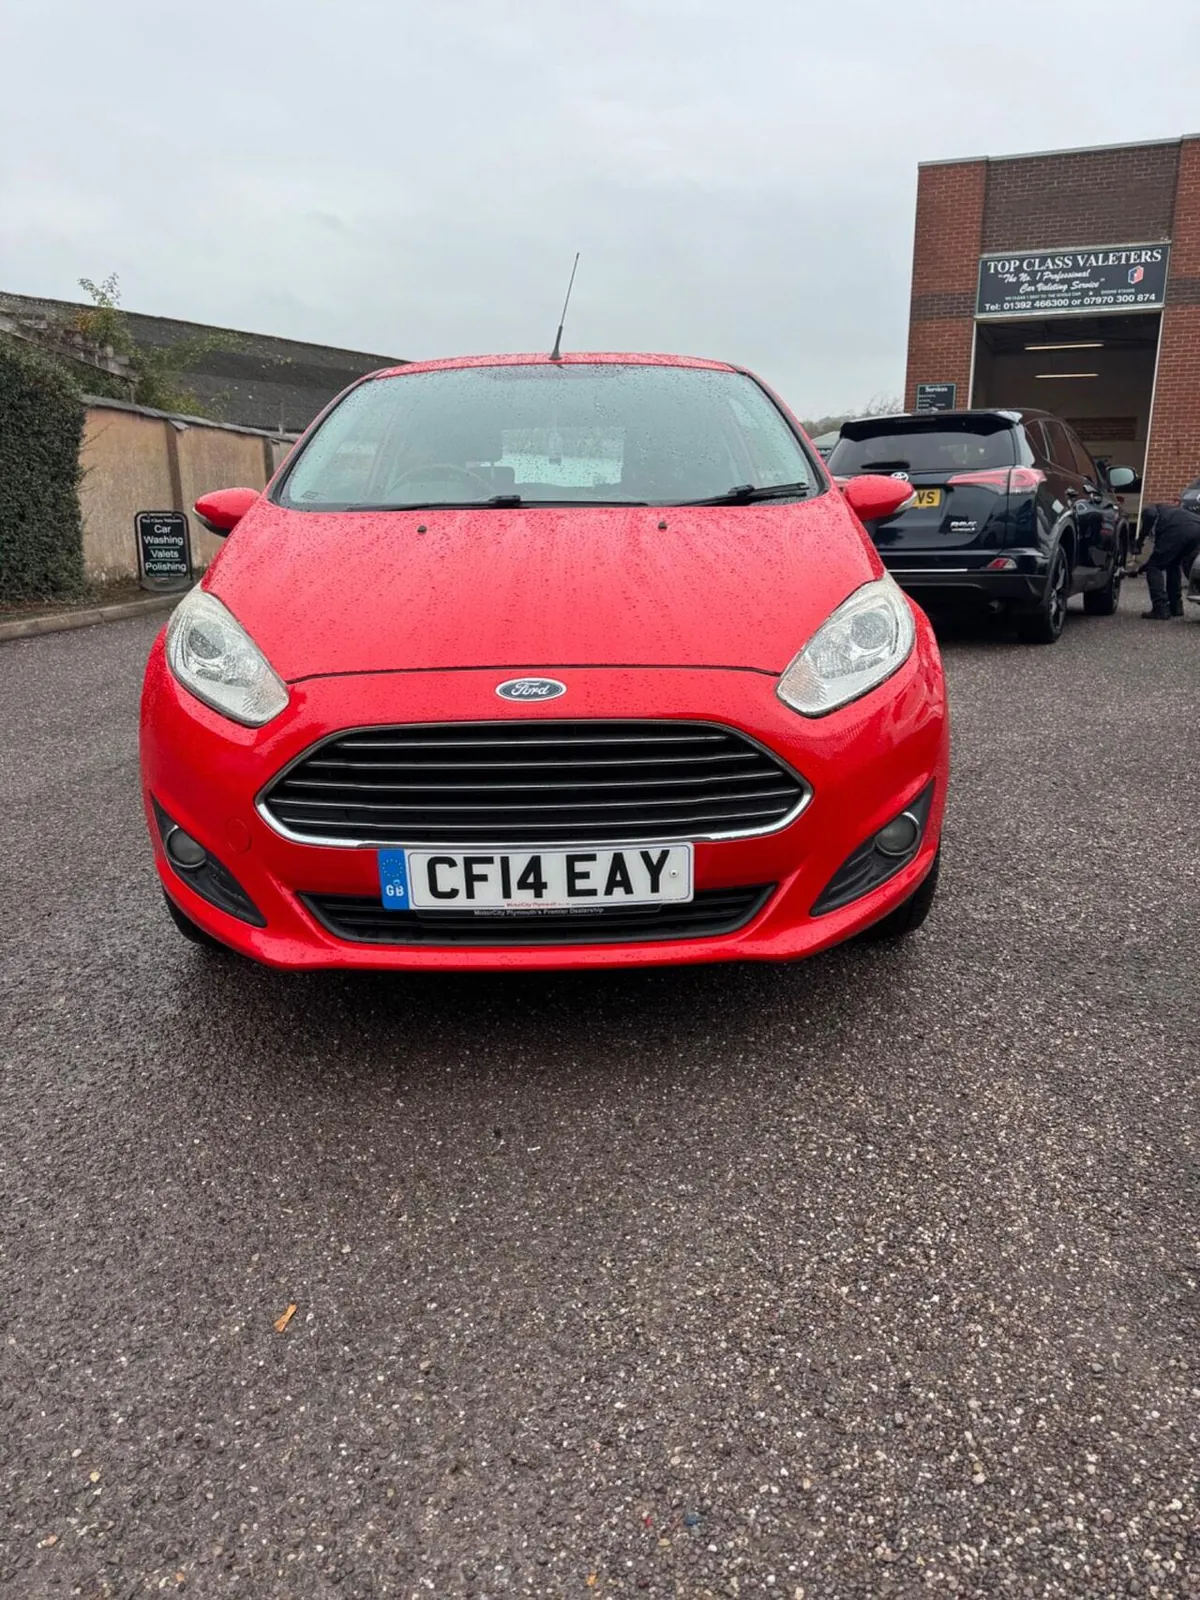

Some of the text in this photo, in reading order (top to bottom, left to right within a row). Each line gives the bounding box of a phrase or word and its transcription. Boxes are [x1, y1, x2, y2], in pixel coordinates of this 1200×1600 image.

[987, 249, 1162, 273] TOP CLASS VALETERS
[1043, 269, 1091, 281] Professional
[1020, 283, 1035, 294] Car
[1036, 282, 1068, 292] Valeting
[985, 303, 1000, 311] Tel:
[1003, 301, 1032, 310] 01392
[1034, 299, 1069, 308] 466300
[1083, 296, 1113, 305] 07970
[1116, 294, 1135, 303] 300
[154, 524, 171, 533] Car
[144, 535, 184, 546] Washing
[151, 550, 179, 558] Valets
[145, 562, 187, 572] Polishing
[511, 681, 550, 696] Ford
[426, 849, 671, 900] CF14 EAY
[386, 884, 405, 896] GB
[570, 903, 605, 914] Dealership
